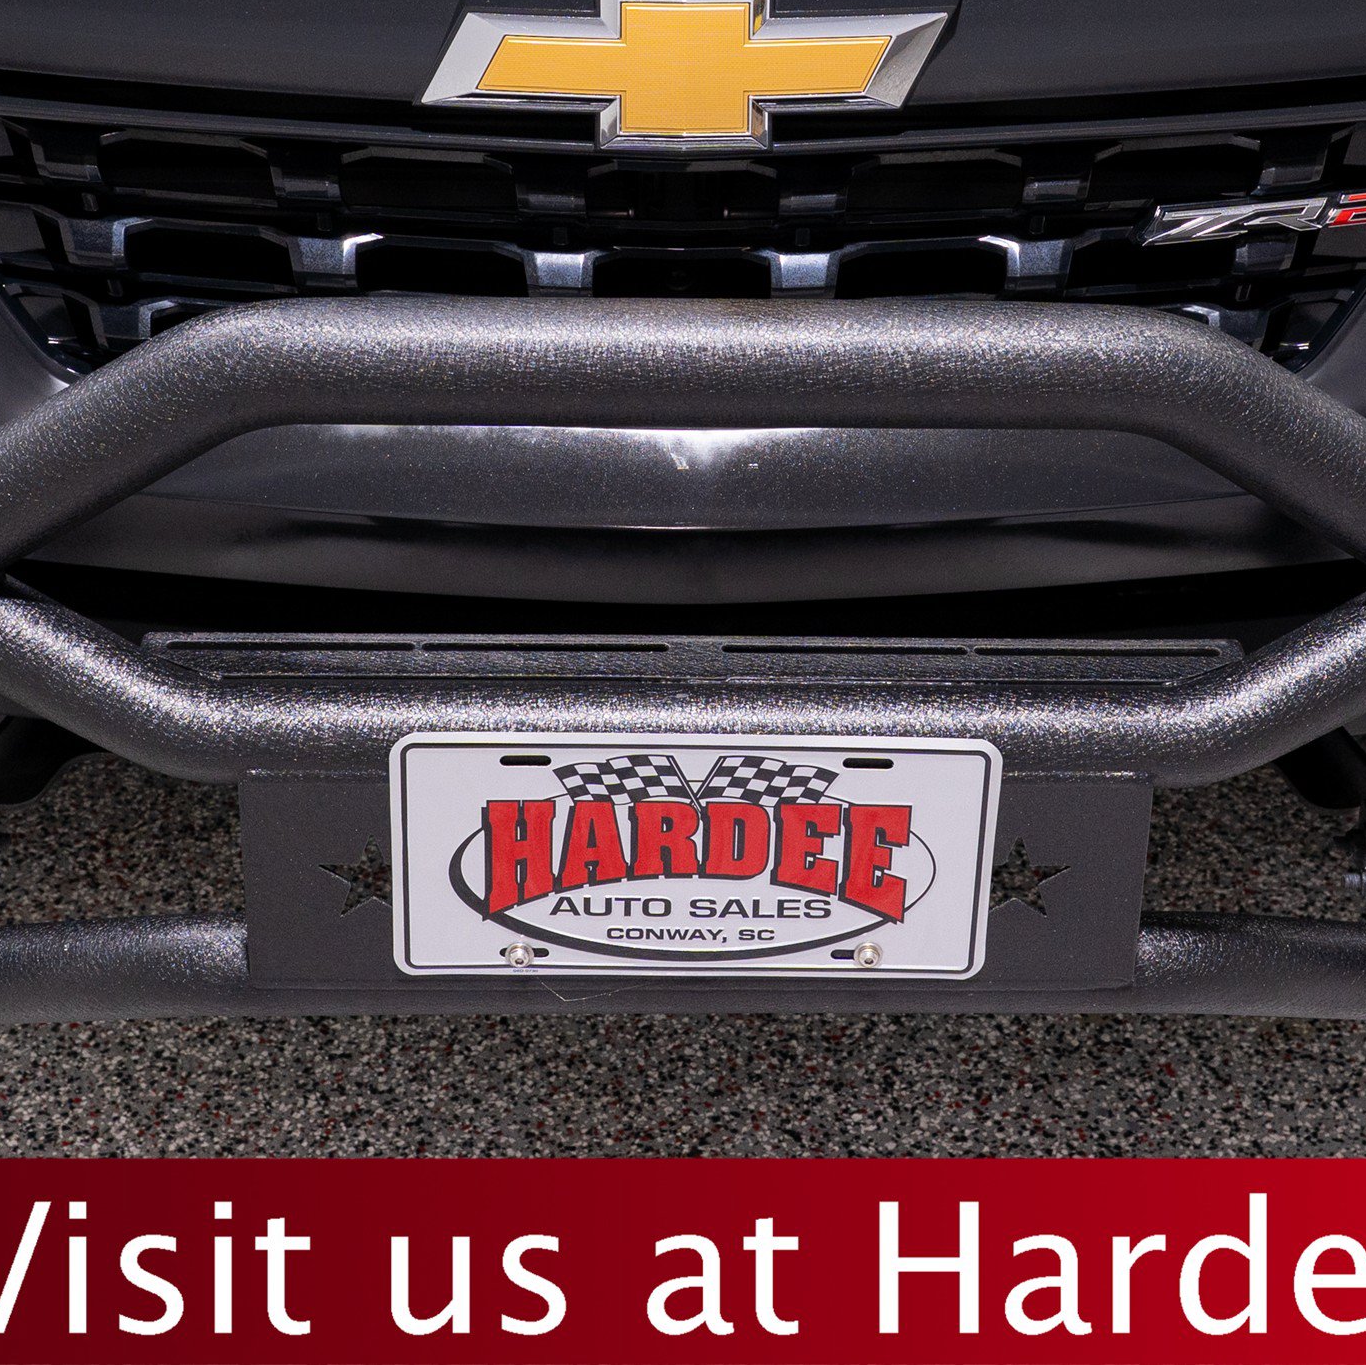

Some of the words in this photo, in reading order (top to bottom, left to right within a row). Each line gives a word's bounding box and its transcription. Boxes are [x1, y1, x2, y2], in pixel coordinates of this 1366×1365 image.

[481, 799, 912, 924] HARDEE
[549, 896, 673, 918] AUTO
[689, 897, 833, 920] SALES
[605, 926, 727, 944] CONWAY,
[738, 927, 776, 942] SC
